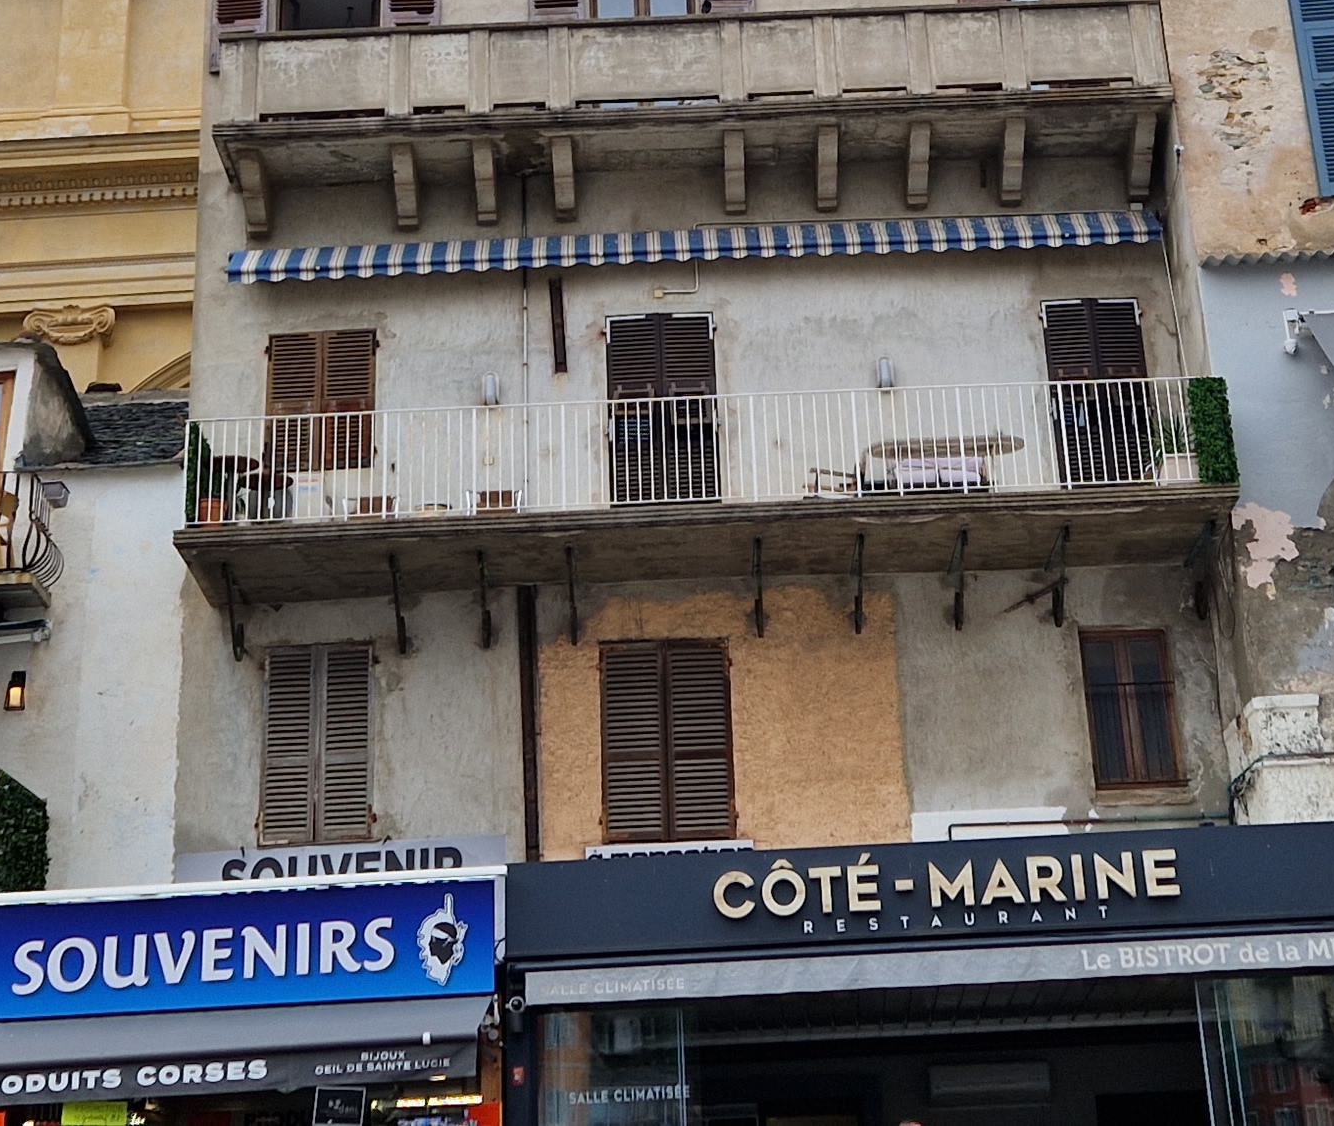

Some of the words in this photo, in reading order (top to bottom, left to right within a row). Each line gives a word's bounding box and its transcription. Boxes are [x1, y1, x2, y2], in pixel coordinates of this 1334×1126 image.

[803, 905, 1108, 934] RESTAURANT
[11, 916, 396, 996] SOUVENIRS
[1080, 949, 1111, 971] Le
[1117, 942, 1231, 969] BISTROT
[1239, 942, 1270, 964] de
[1276, 940, 1301, 962] la
[346, 1062, 363, 1073] DE
[366, 1060, 412, 1072] SAINTE
[414, 1058, 451, 1070] LUCIE
[361, 1050, 406, 1061] BIJOUX
[136, 1059, 268, 1086] CORSES
[569, 1089, 609, 1105] SALLE
[613, 1083, 690, 1103] CLIMATISÉE
